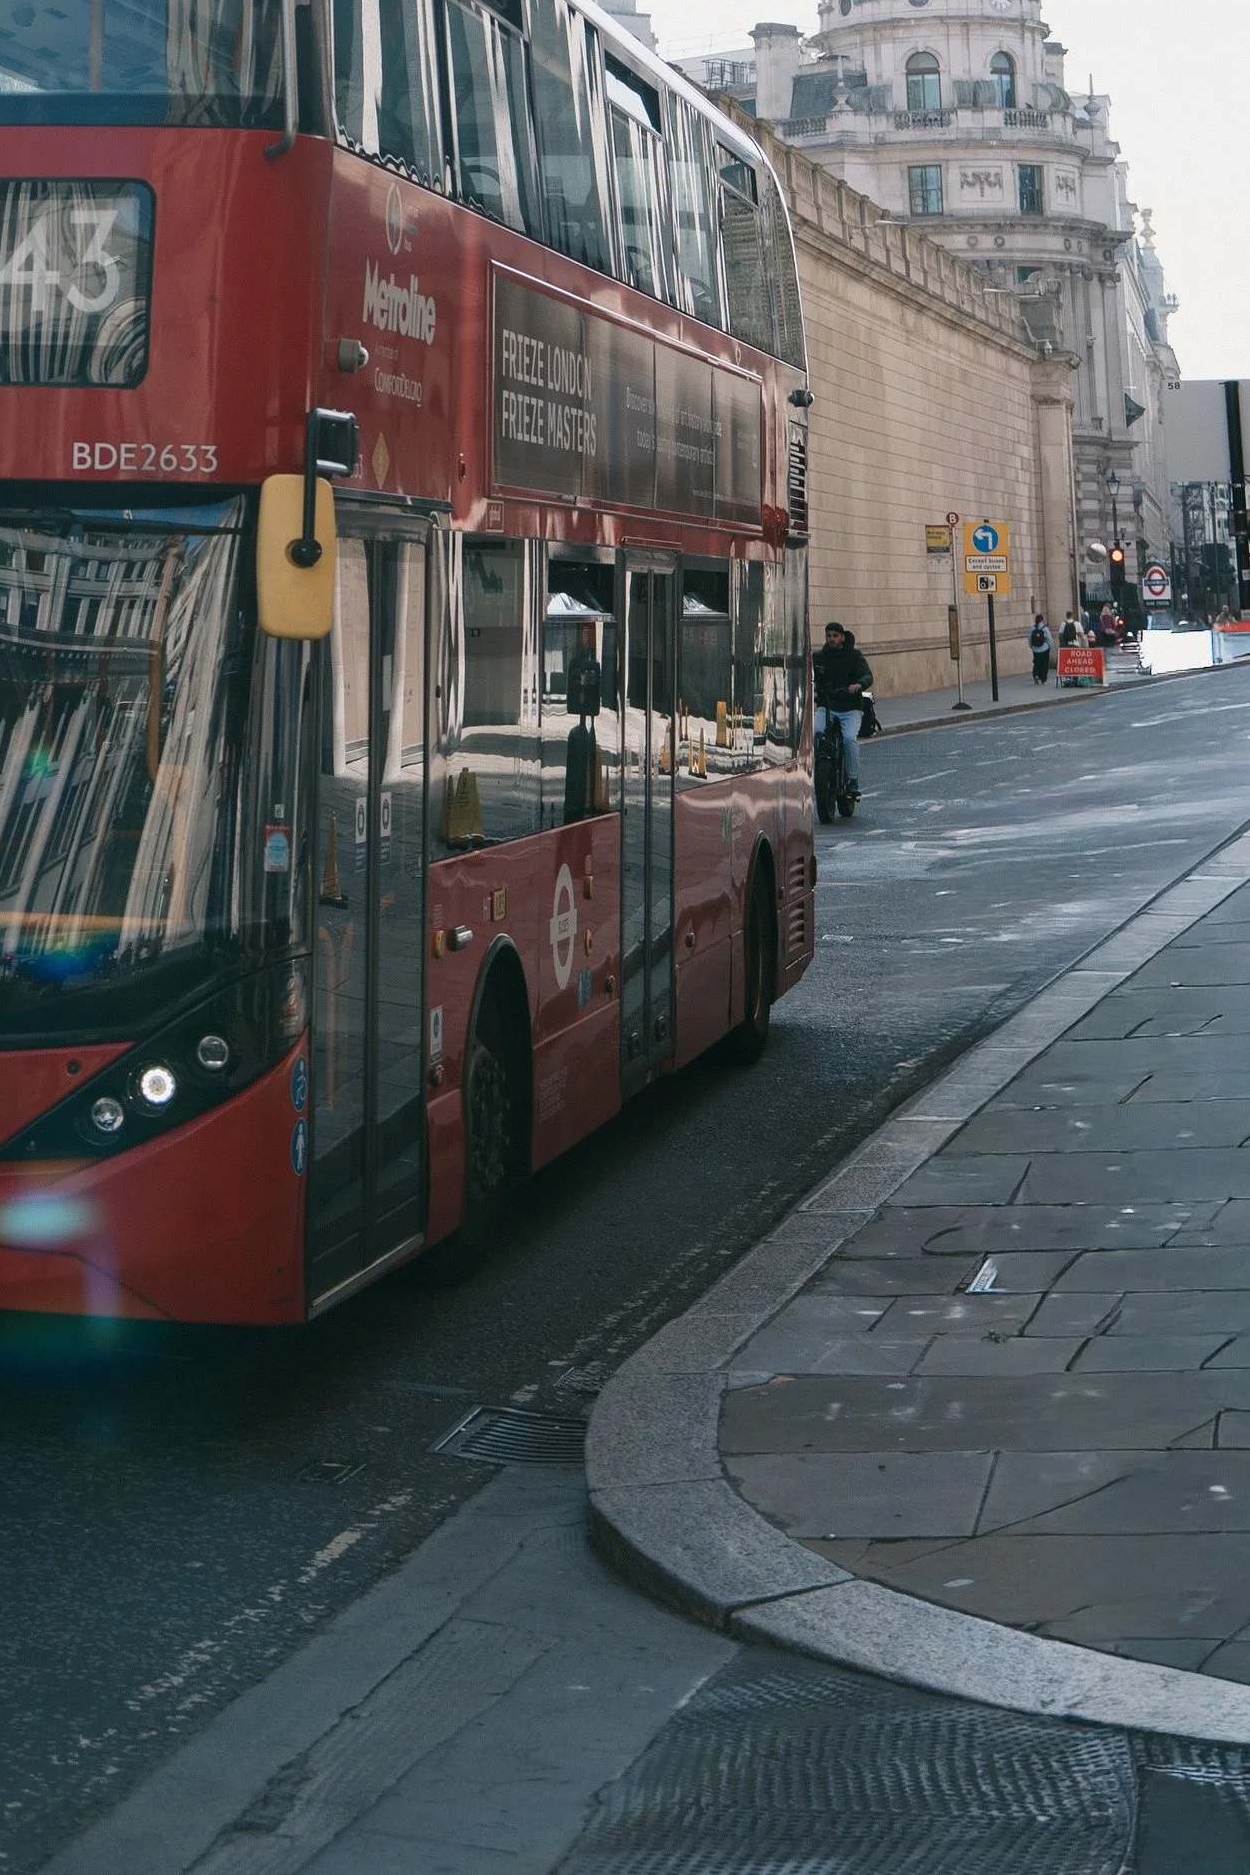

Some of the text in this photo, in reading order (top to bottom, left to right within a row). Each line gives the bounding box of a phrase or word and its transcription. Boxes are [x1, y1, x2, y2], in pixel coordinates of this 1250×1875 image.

[362, 257, 437, 345] Metroline
[502, 329, 592, 401] FRIEZE LONDON
[1167, 382, 1181, 390] 58
[502, 389, 544, 445] FRIEZE
[547, 401, 597, 457] MASTERS
[72, 441, 220, 474] BDE2633
[950, 514, 956, 523] B
